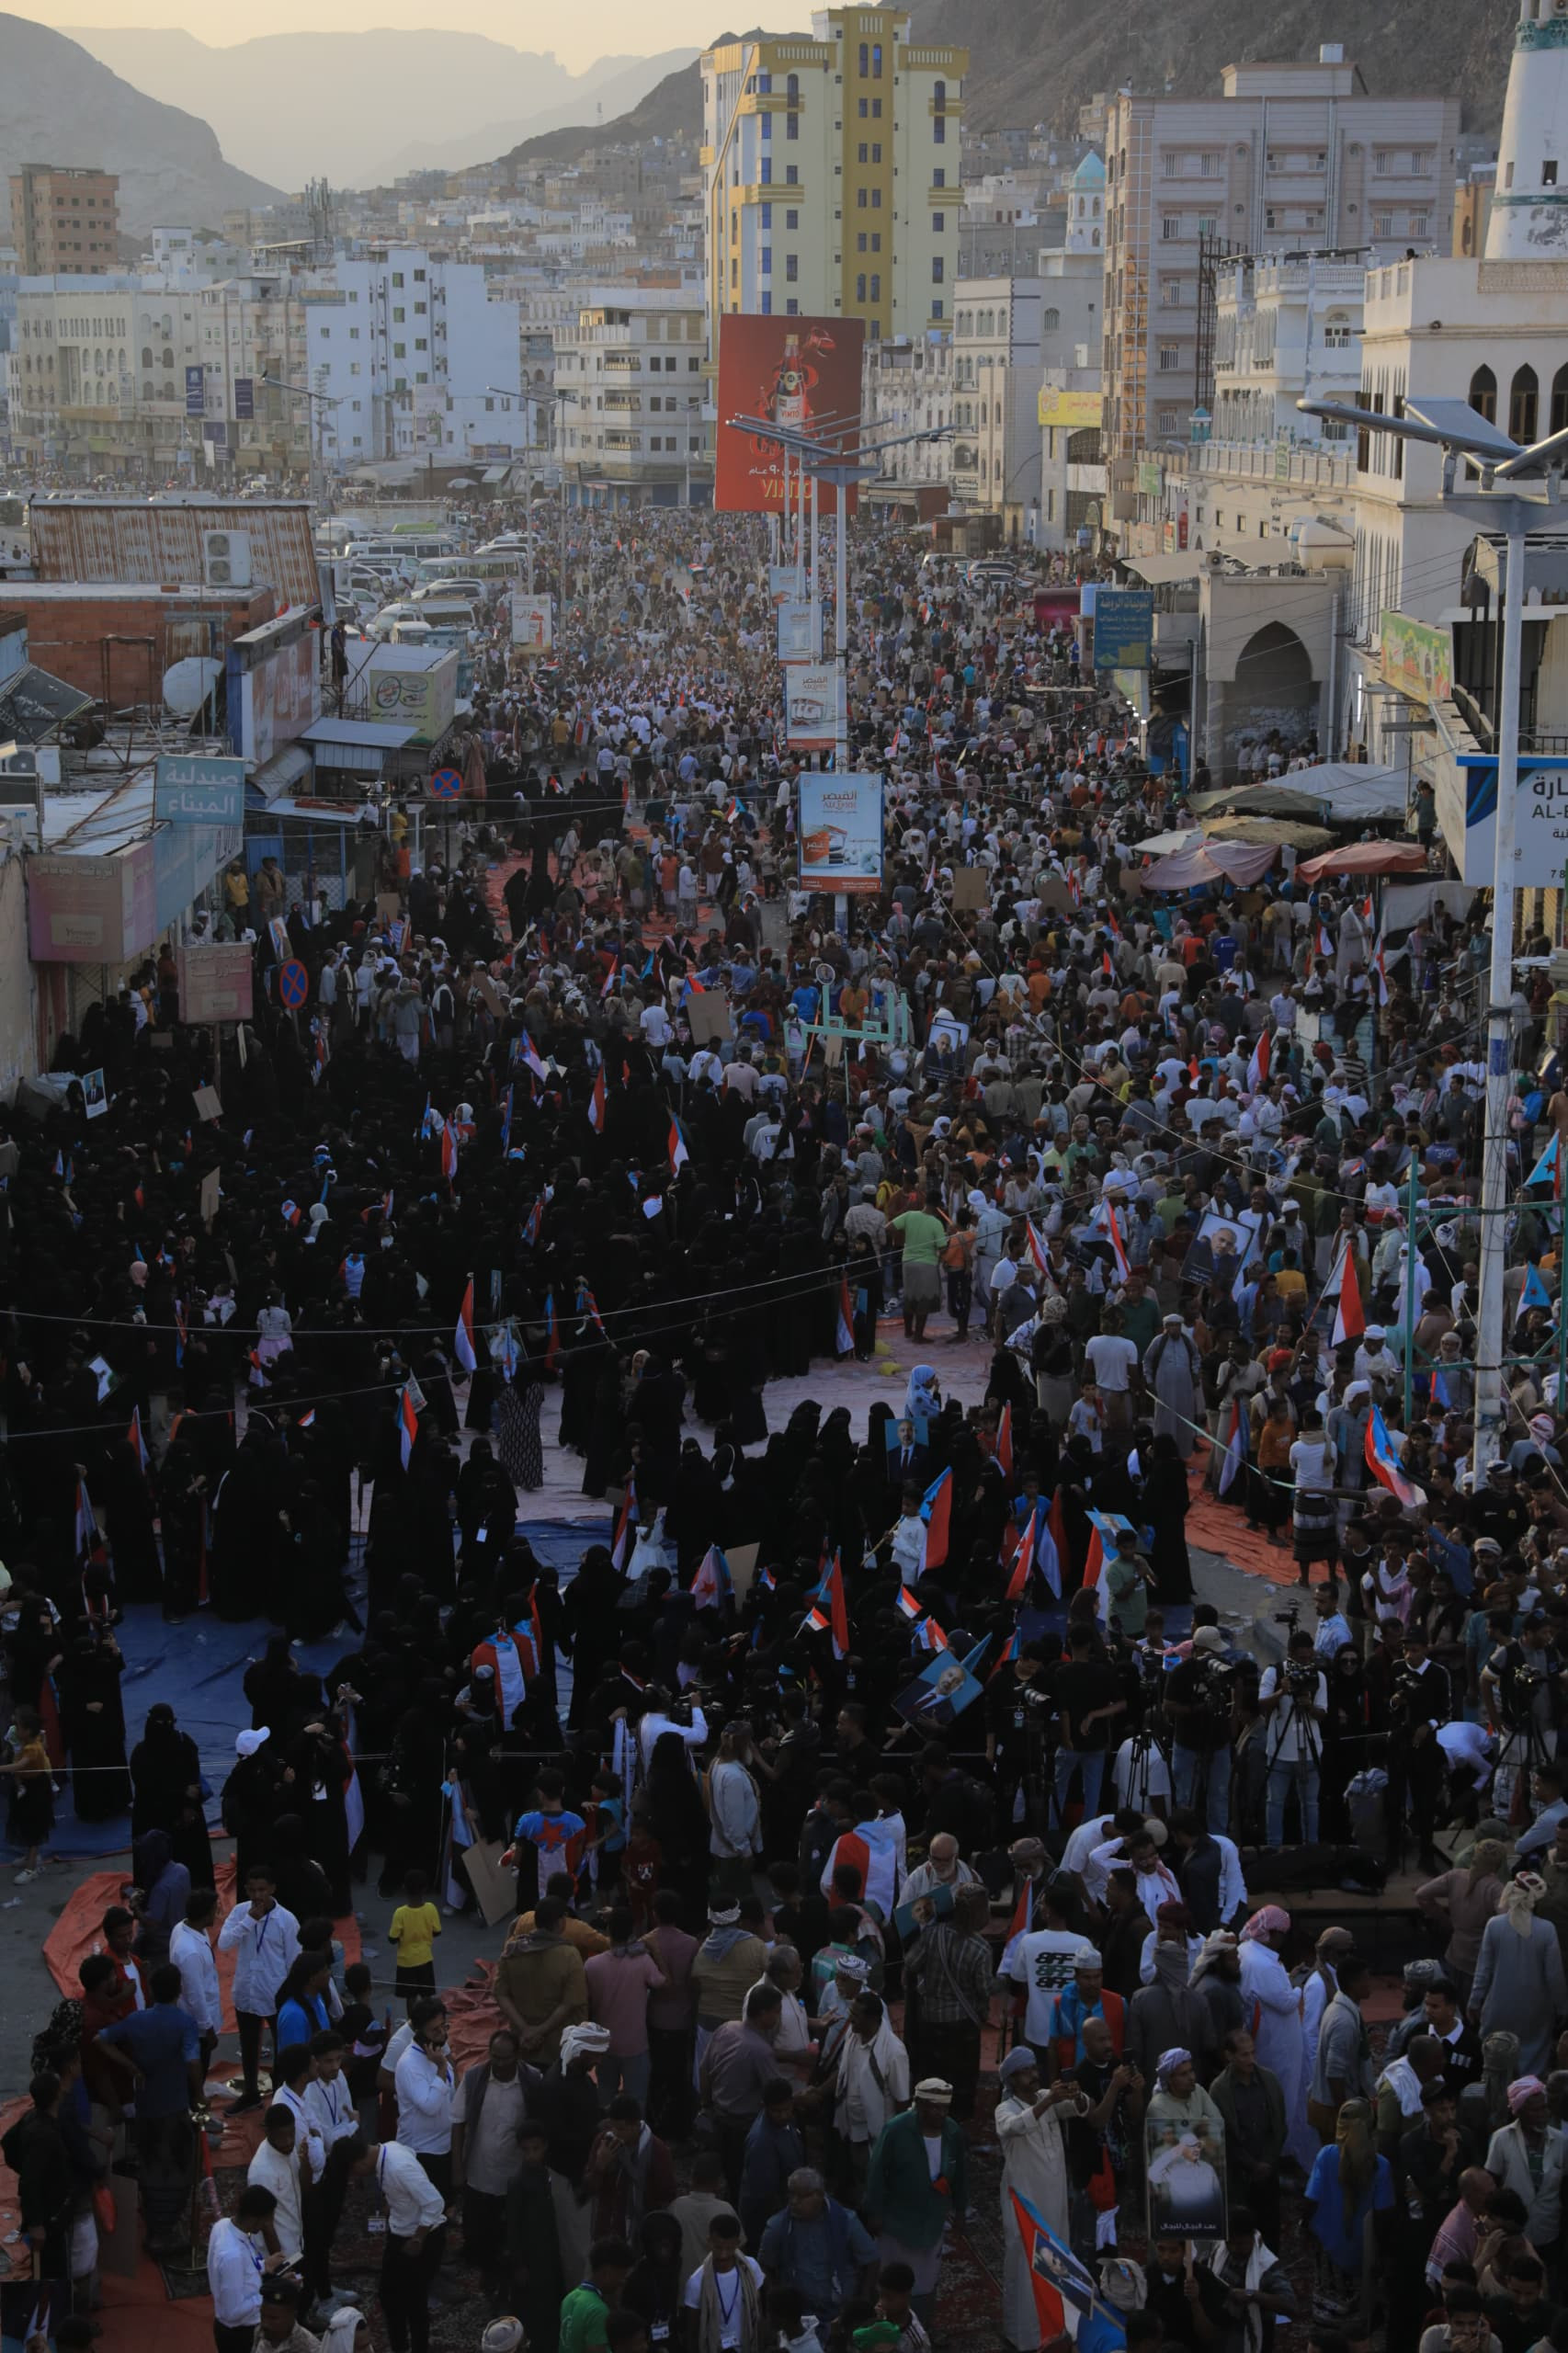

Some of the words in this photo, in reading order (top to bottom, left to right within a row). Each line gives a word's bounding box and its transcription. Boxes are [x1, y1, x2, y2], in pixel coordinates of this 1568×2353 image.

[761, 478, 813, 498] VIMTO
[165, 763, 238, 790] صيدلية
[168, 793, 235, 816] الميناء
[823, 790, 857, 801] القيصر
